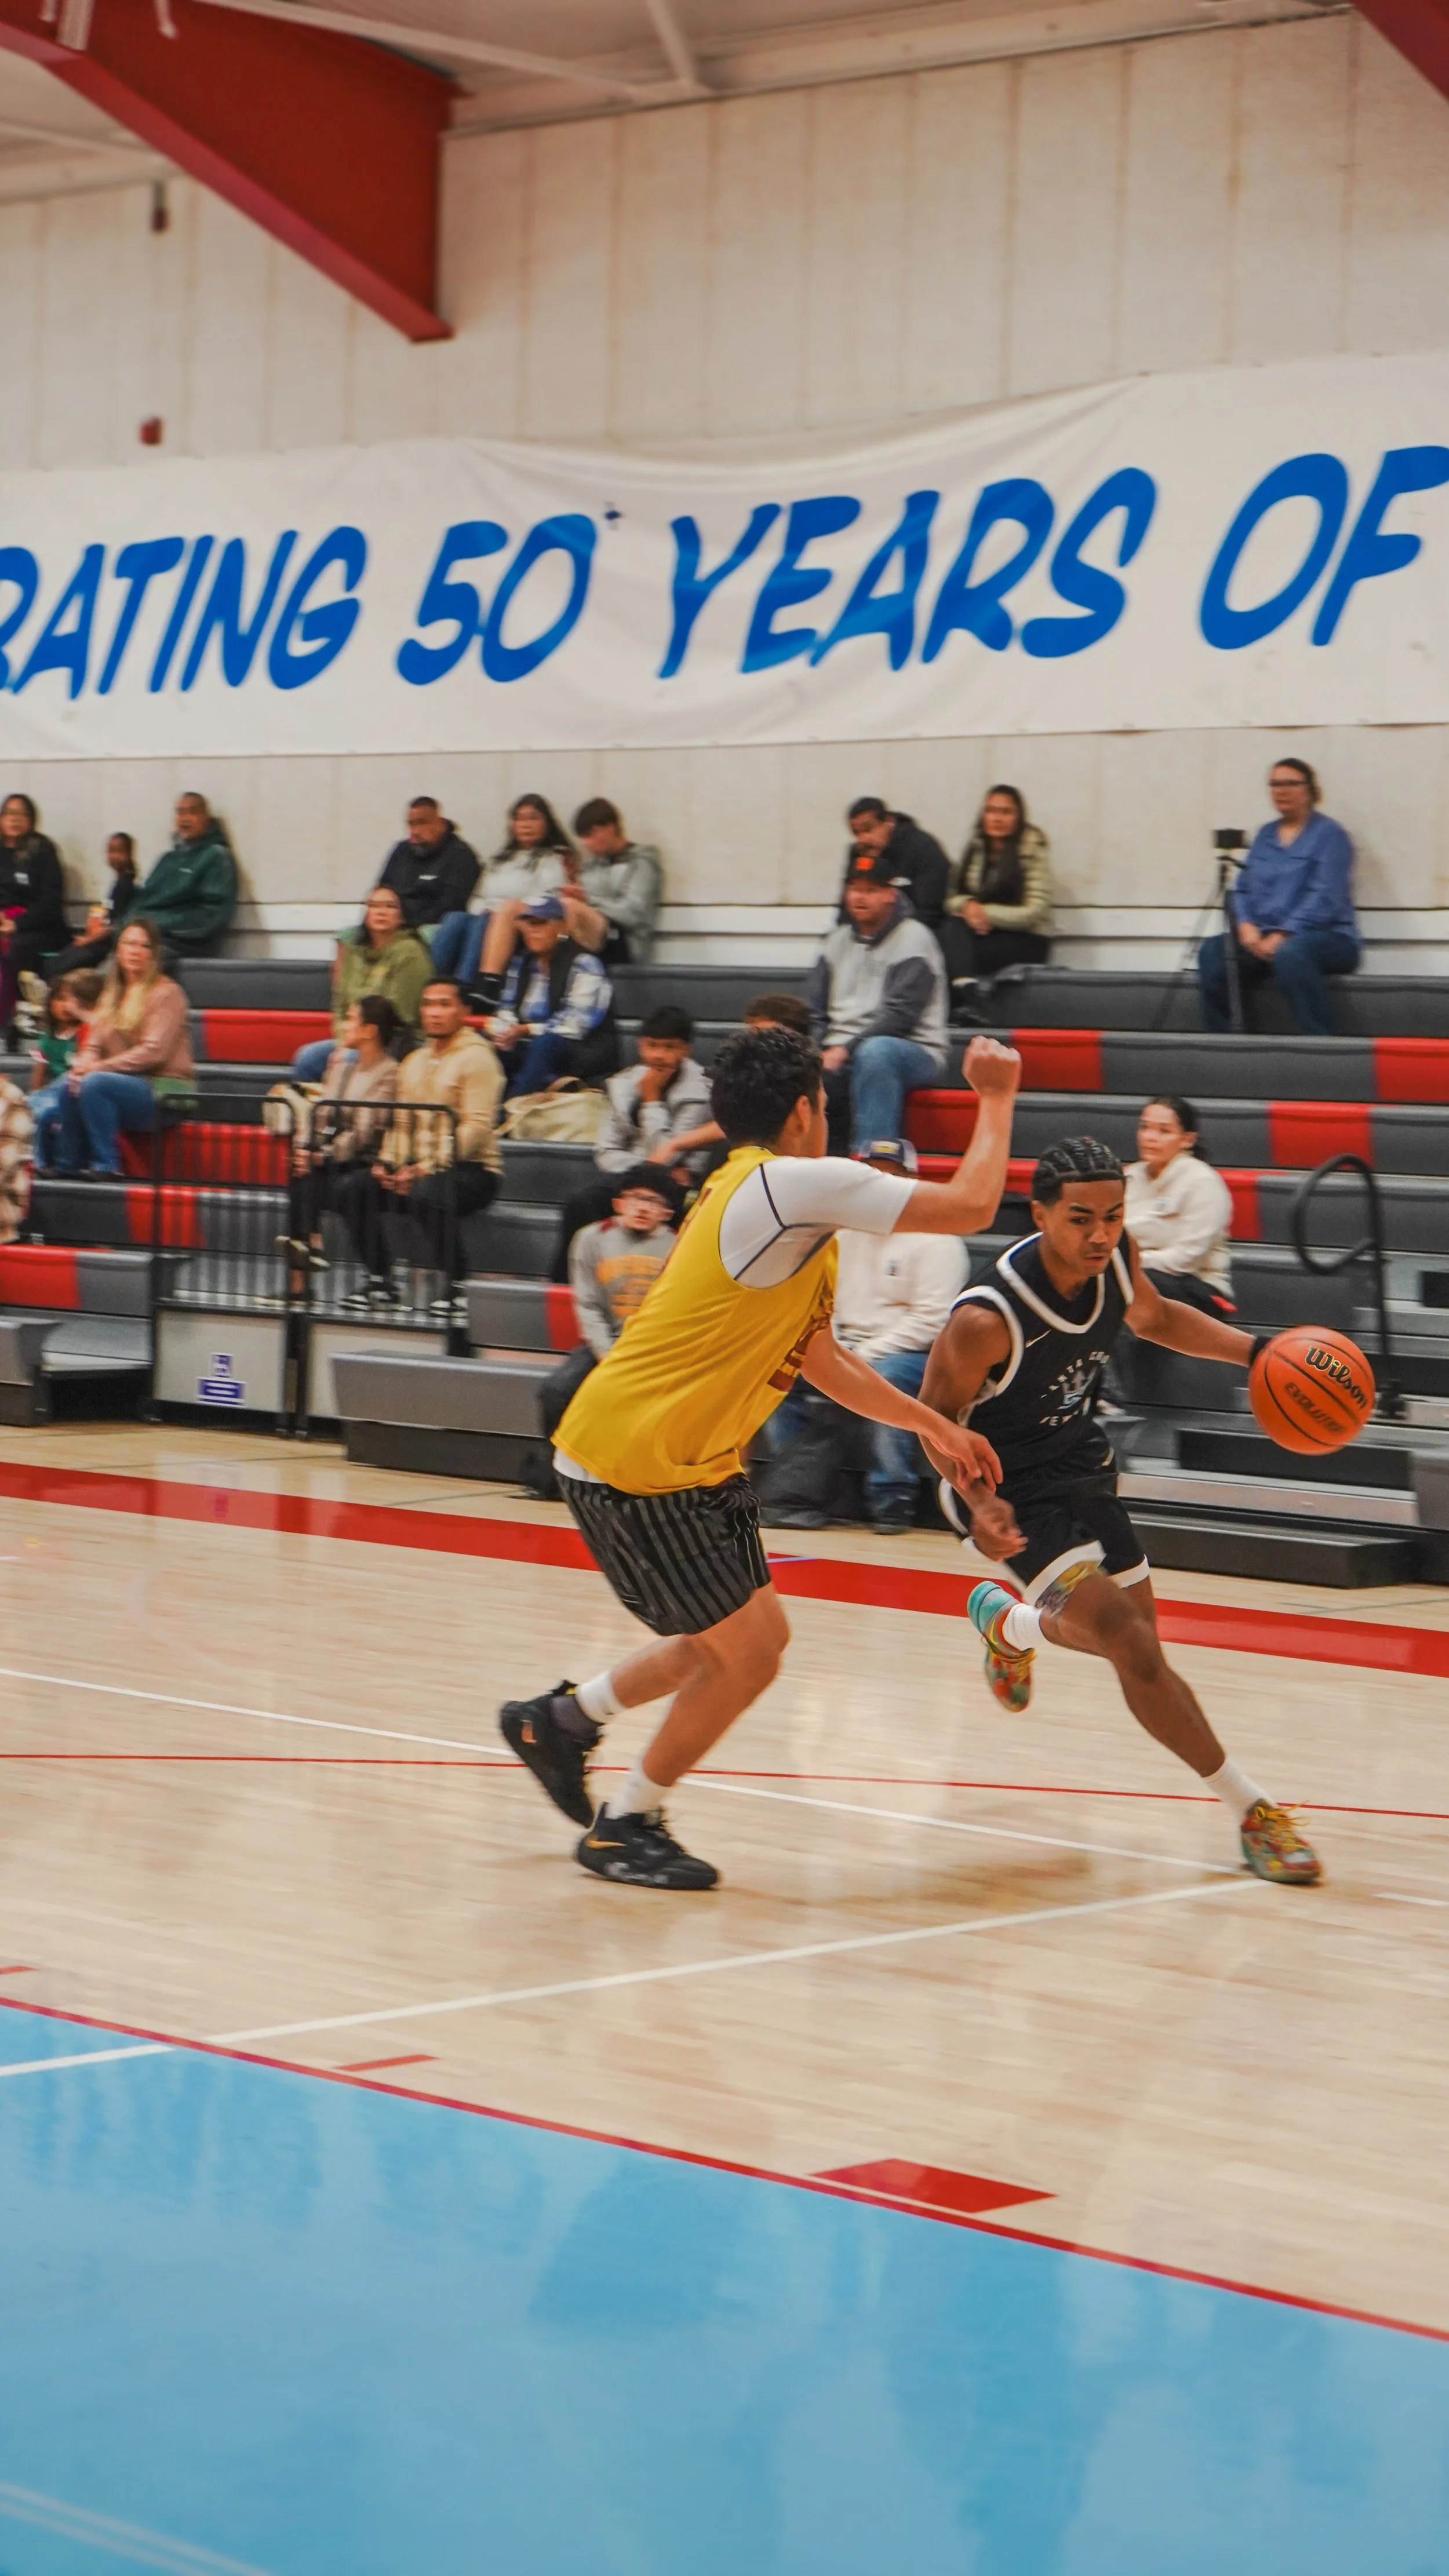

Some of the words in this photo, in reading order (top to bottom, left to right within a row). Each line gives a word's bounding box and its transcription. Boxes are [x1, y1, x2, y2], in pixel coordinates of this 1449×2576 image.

[396, 514, 596, 685] 50
[659, 467, 1156, 678] YEARS
[1200, 446, 1449, 649] OF
[1305, 1346, 1367, 1409] Wilson
